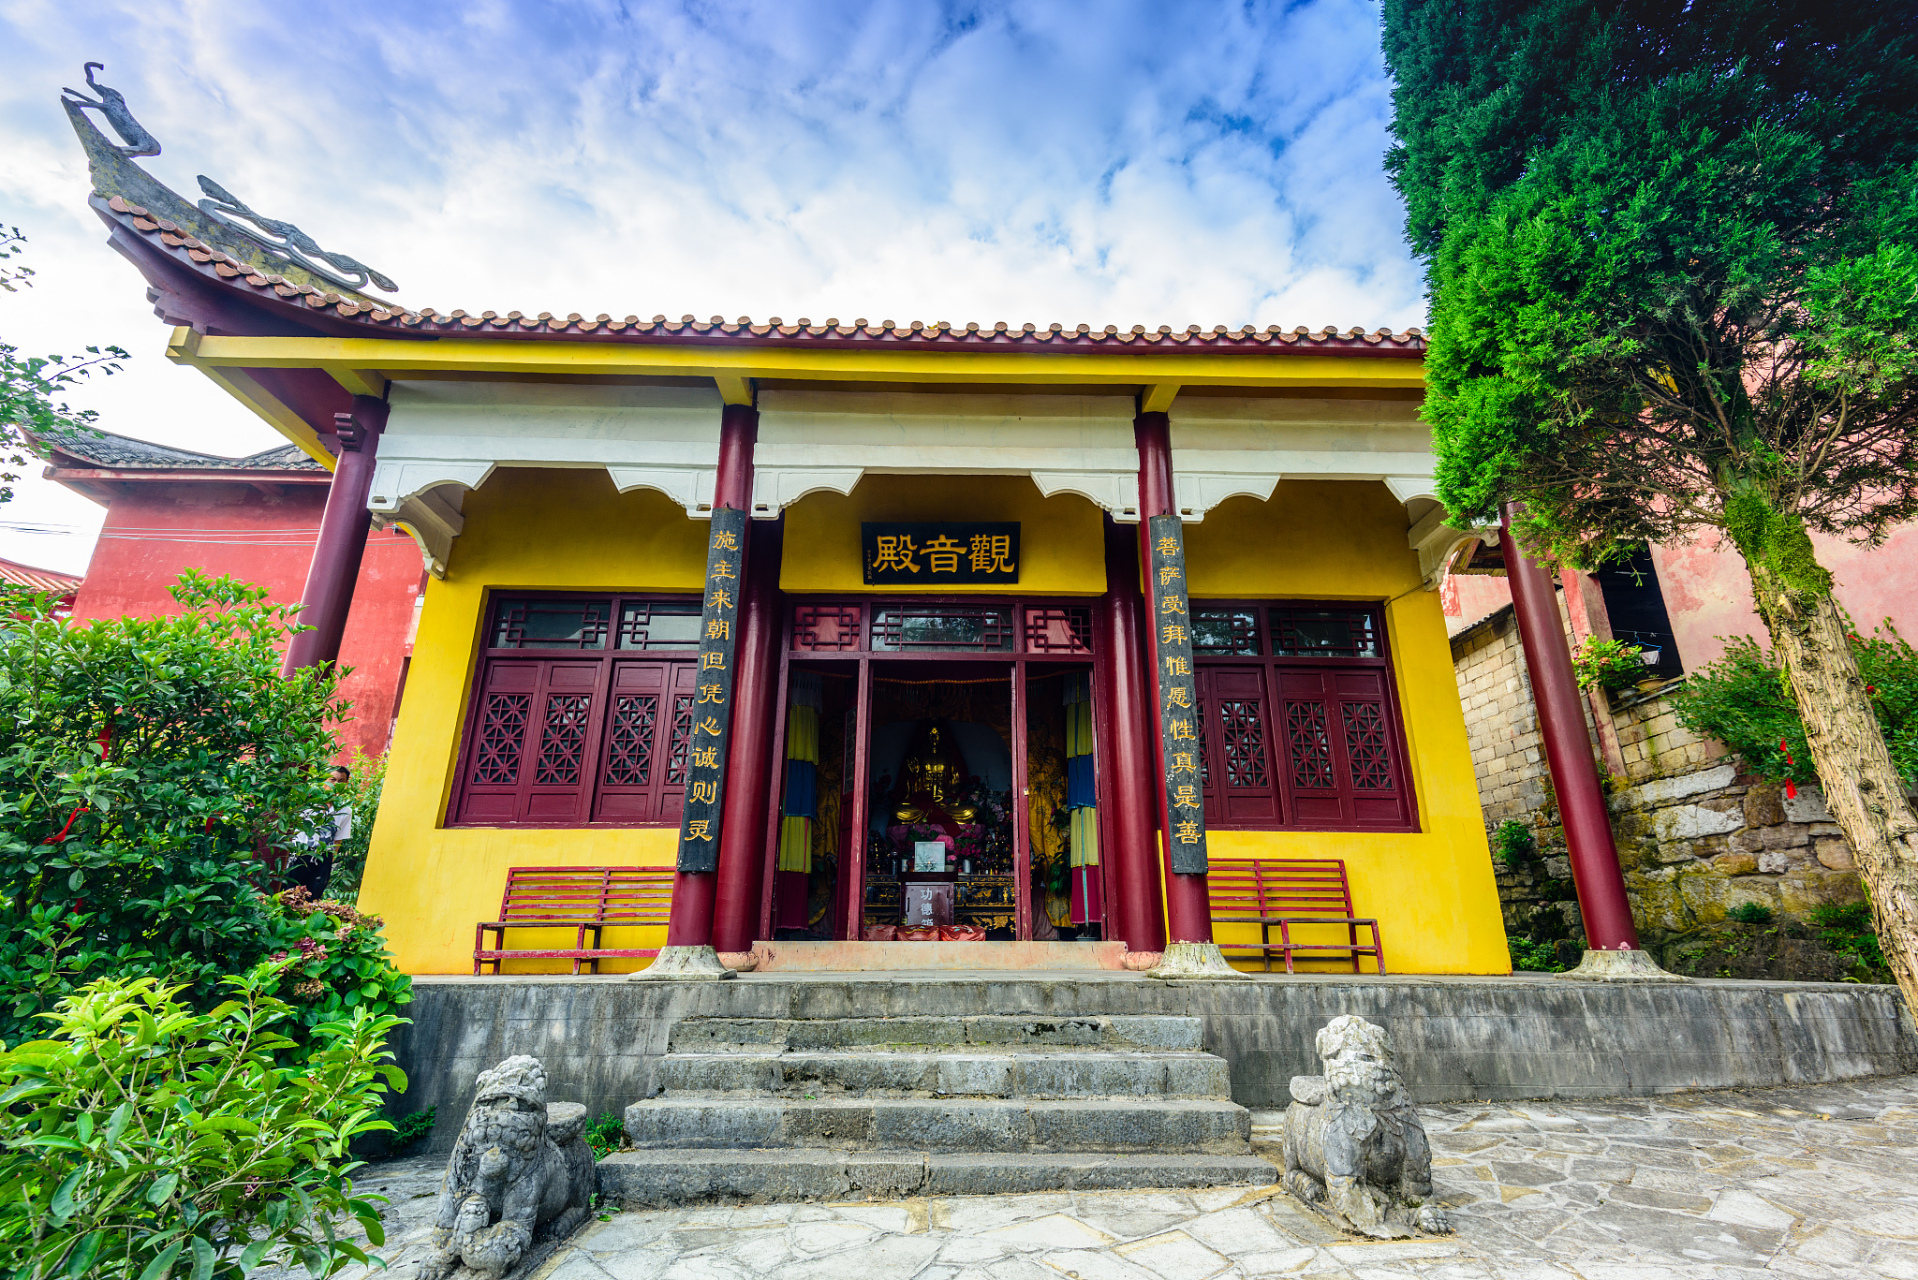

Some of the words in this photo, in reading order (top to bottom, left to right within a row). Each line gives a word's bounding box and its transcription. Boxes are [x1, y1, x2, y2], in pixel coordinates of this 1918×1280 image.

[684, 530, 738, 841] 施主来朝但凭心诚则灵
[873, 534, 1015, 573] 觀音殿
[1156, 537, 1202, 844] 菩萨受拜惟愿性真是善
